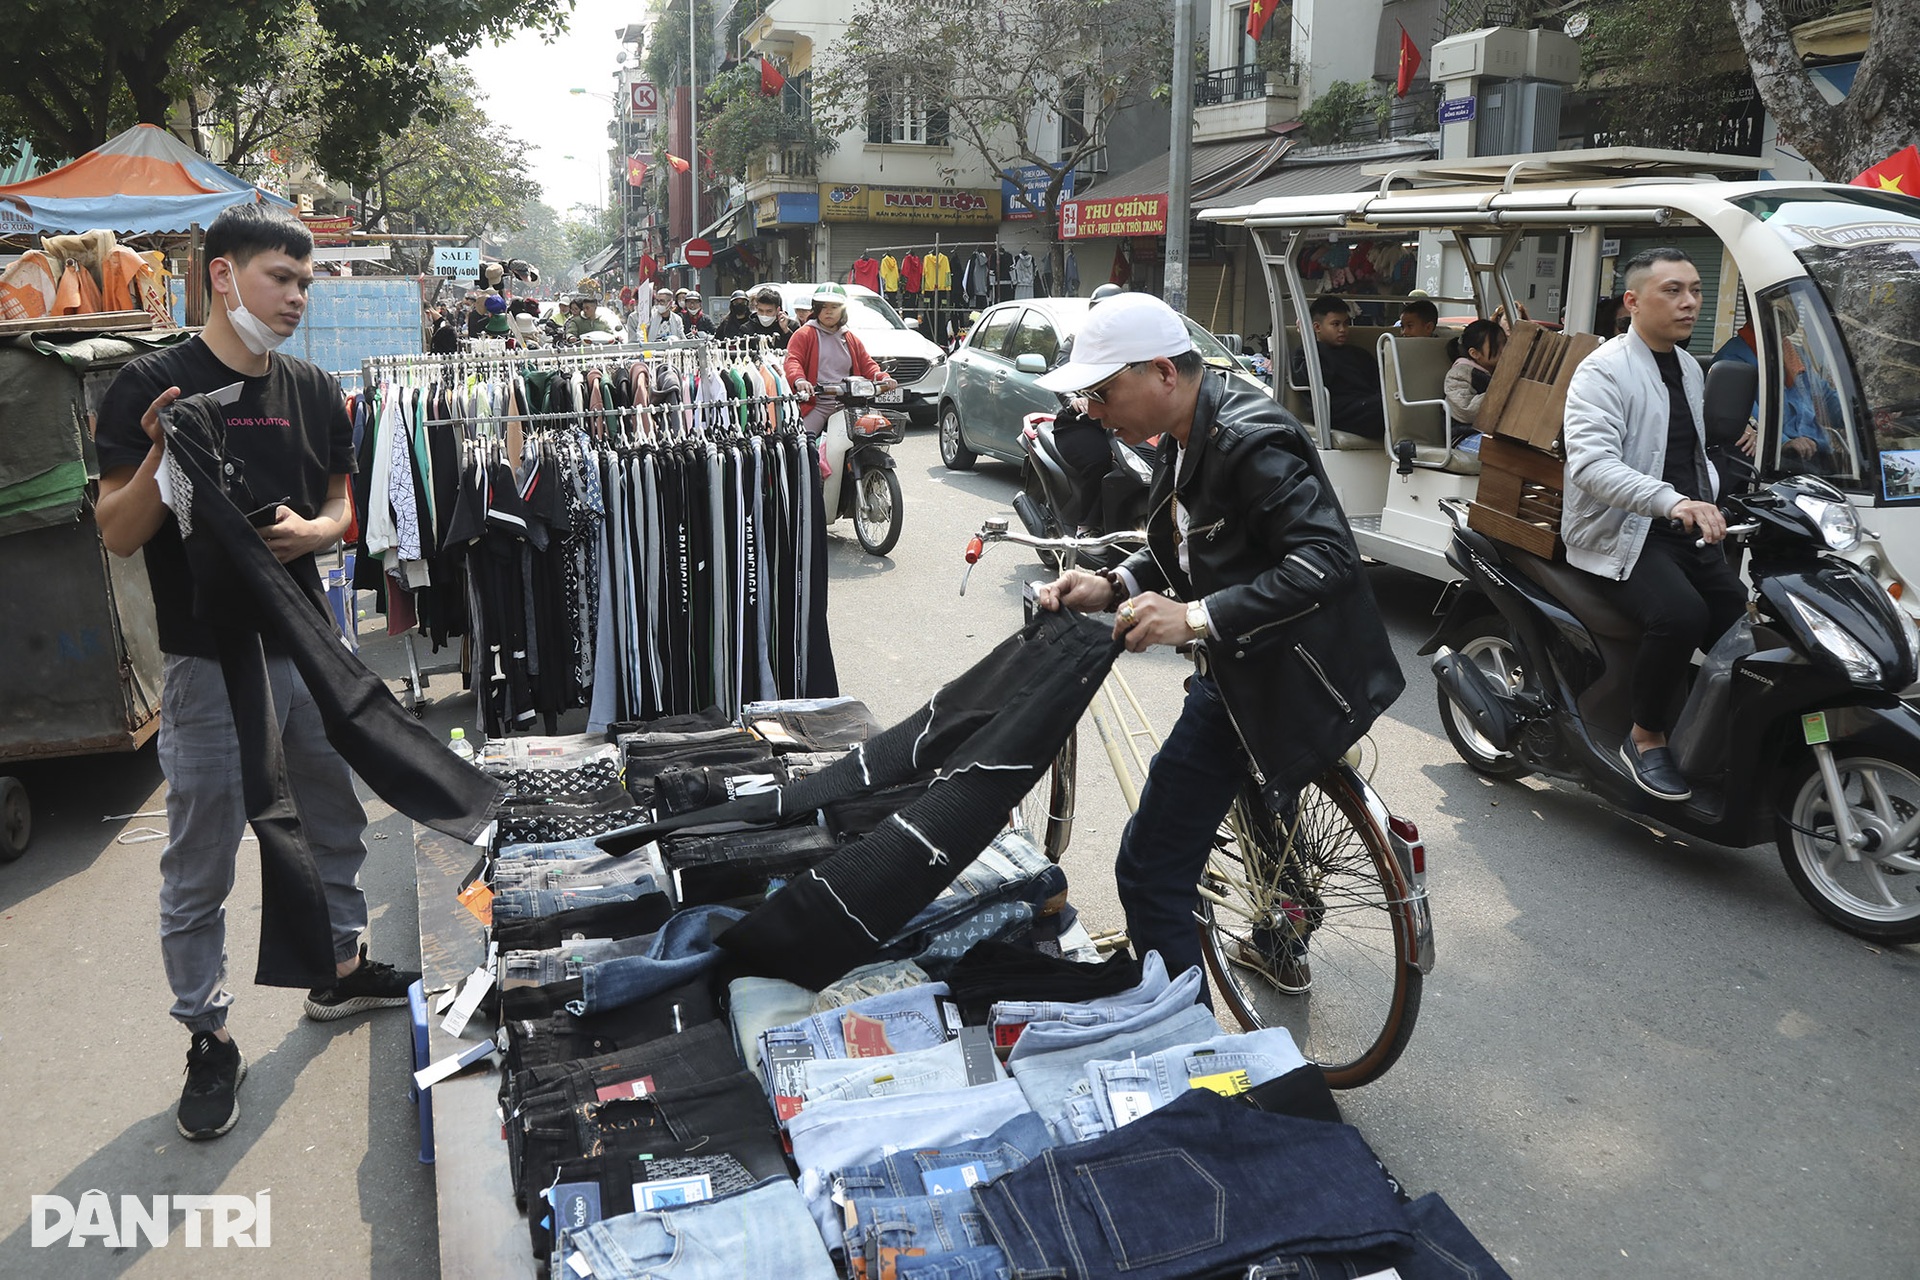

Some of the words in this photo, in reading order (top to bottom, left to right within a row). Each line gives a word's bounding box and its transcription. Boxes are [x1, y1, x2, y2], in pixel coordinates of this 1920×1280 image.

[884, 192, 933, 208] NAM
[1085, 203, 1112, 219] THU
[1114, 197, 1158, 217] CHÍNH
[1098, 222, 1110, 236] PHỤ
[1111, 219, 1126, 235] KIỆN
[1126, 218, 1142, 233] THỜI
[1143, 220, 1163, 232] TRANG
[441, 251, 473, 261] SALE
[226, 417, 254, 426] LOUIS
[1739, 667, 1775, 687] HONDA
